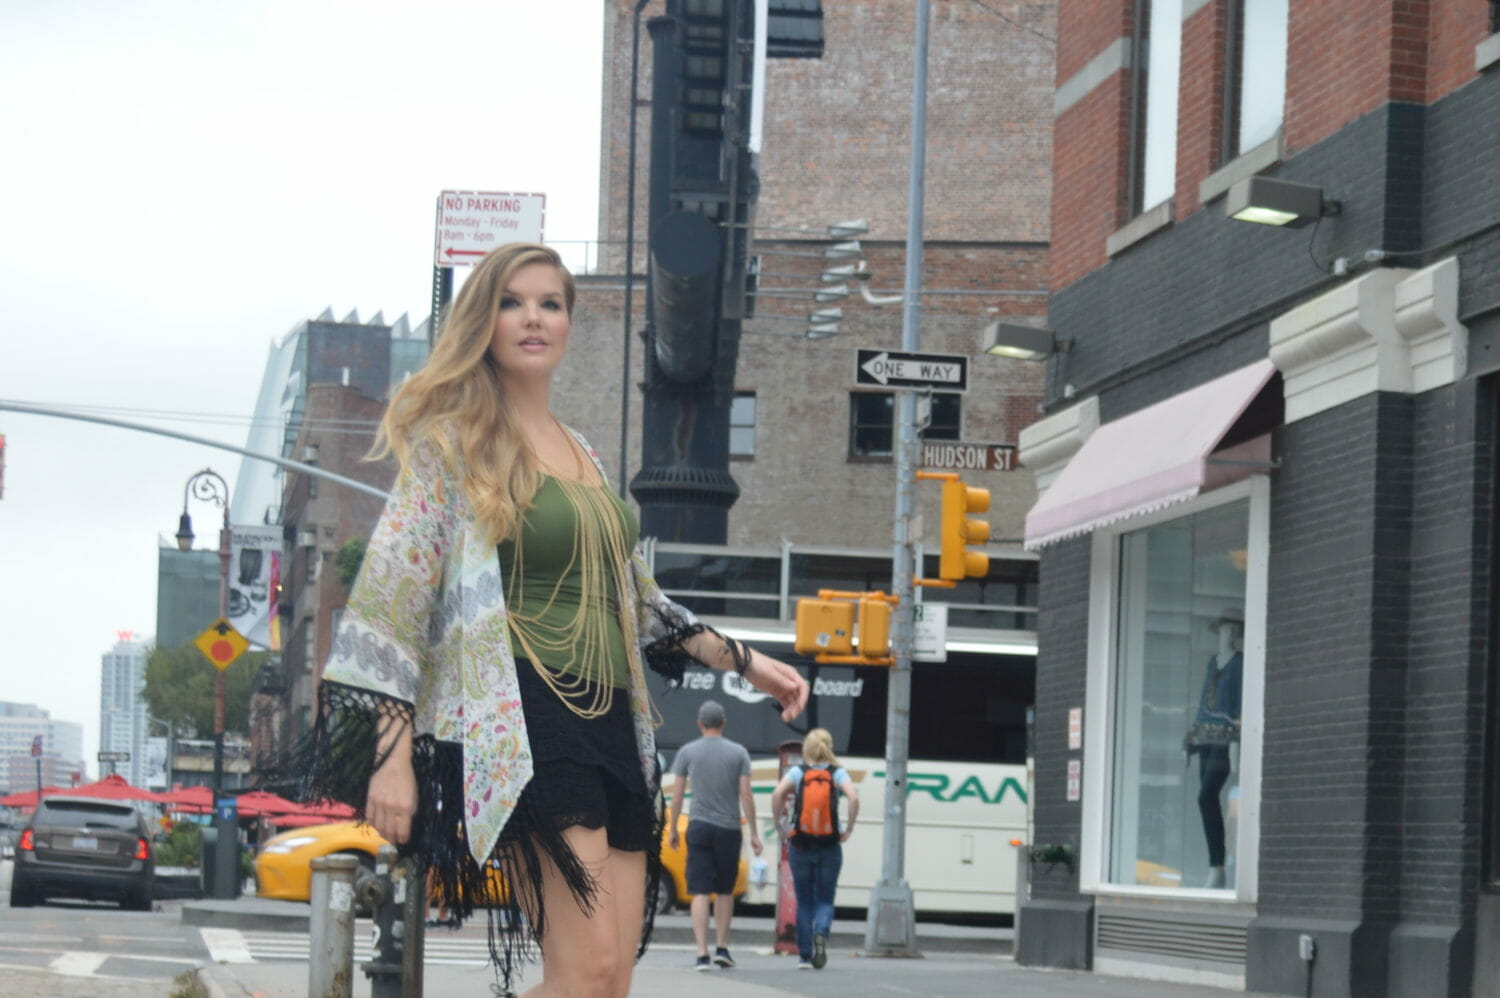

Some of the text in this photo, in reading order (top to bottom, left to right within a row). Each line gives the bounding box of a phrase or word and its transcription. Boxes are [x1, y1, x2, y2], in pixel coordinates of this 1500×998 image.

[445, 198, 521, 213] NO PARKING
[444, 216, 480, 230] Monday
[490, 216, 520, 230] Friday
[873, 360, 953, 380] ONE WAY
[924, 445, 1013, 470] HUDSON ST
[813, 676, 865, 698] board
